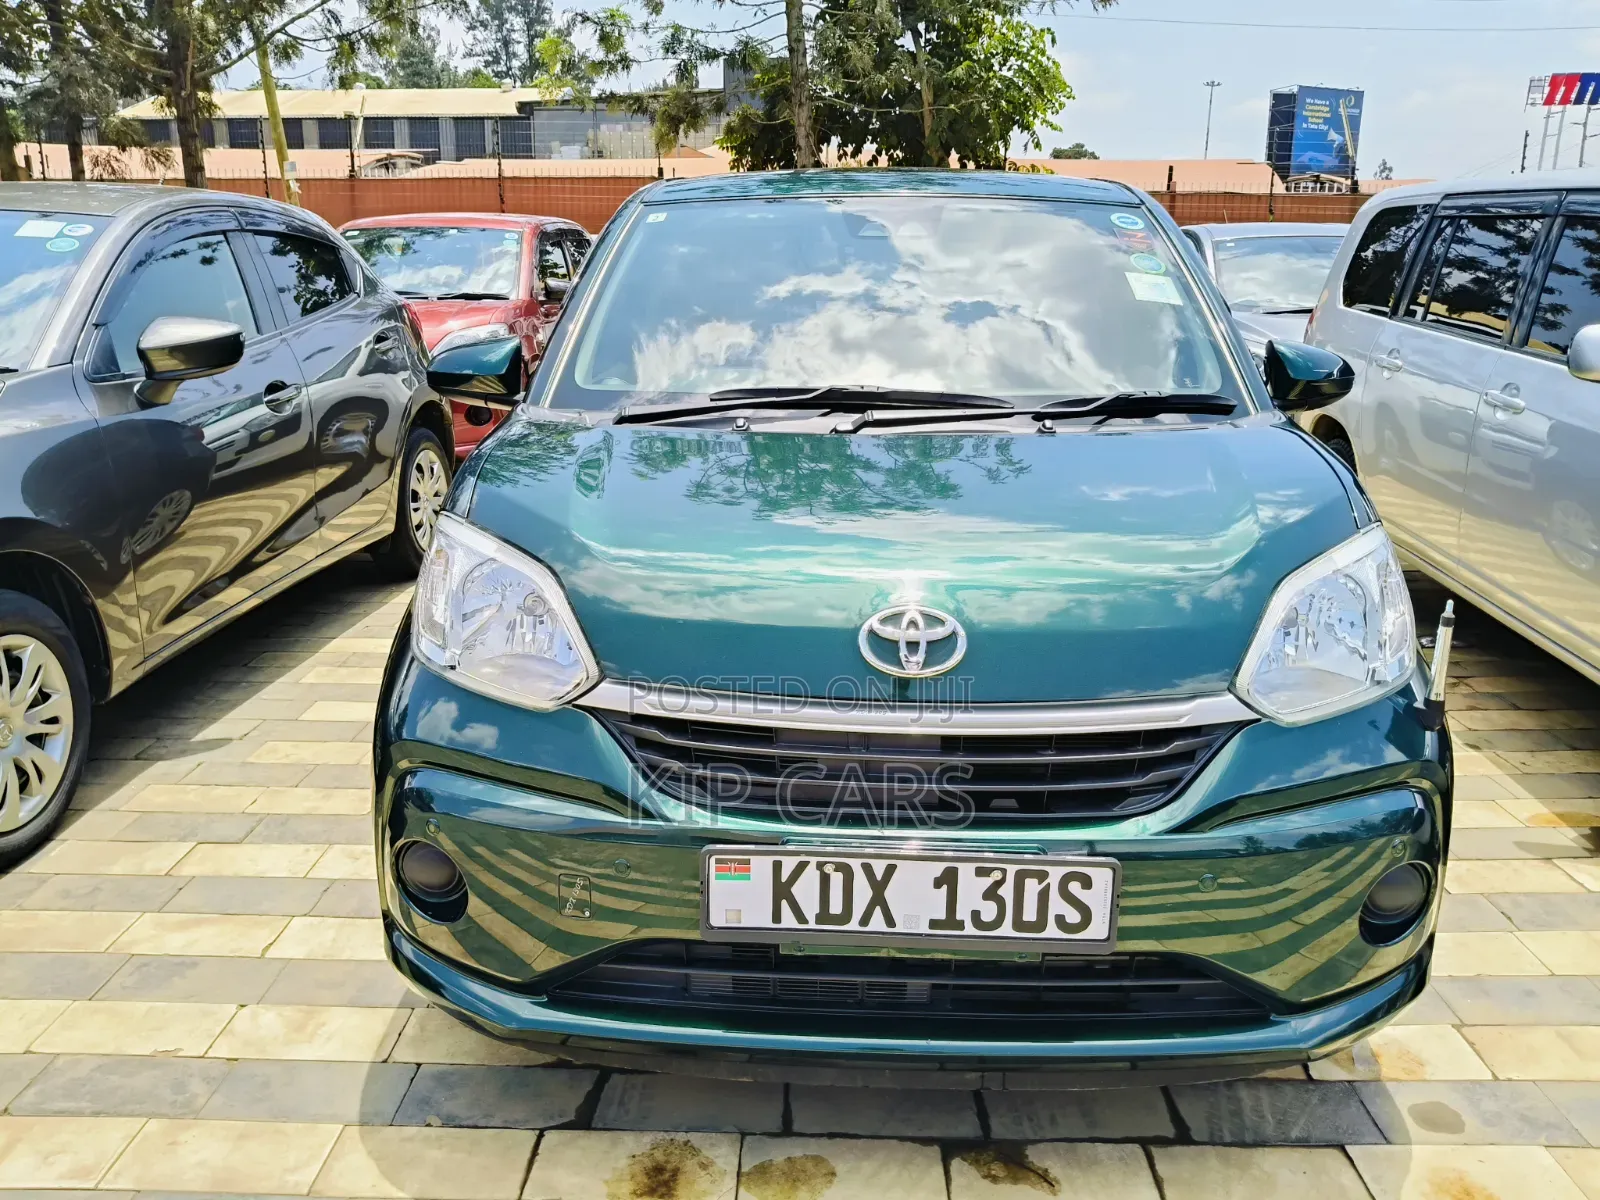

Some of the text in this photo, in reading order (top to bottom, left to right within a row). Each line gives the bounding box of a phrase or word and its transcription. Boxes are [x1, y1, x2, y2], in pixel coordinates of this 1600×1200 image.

[1305, 104, 1330, 112] Cambridge
[1302, 110, 1331, 118] International
[771, 859, 898, 929] KDX
[928, 865, 1093, 935] 130S
